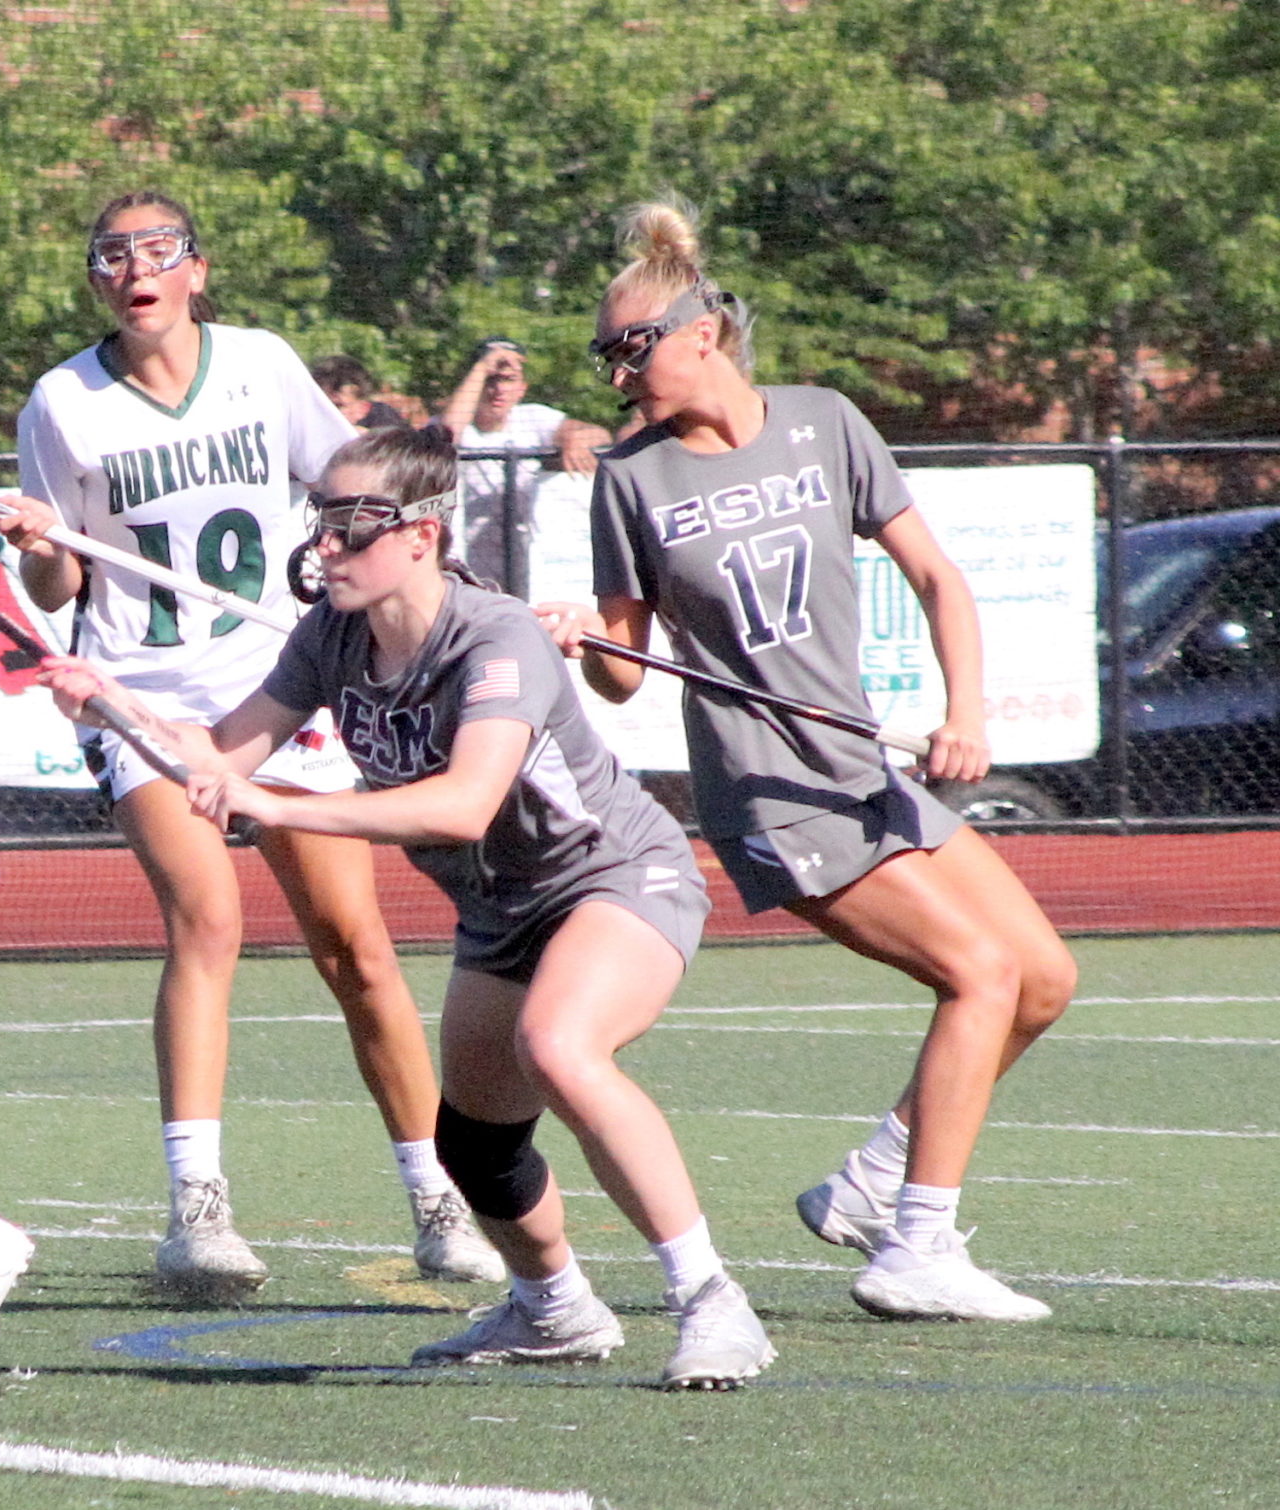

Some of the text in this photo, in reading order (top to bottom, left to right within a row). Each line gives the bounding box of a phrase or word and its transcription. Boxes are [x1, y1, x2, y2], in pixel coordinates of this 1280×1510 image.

[100, 421, 269, 515] HURRICANES
[418, 496, 445, 515] STX
[652, 465, 832, 548] ESM
[124, 508, 266, 647] 19
[716, 523, 813, 655] 17
[340, 688, 449, 777] ESM
